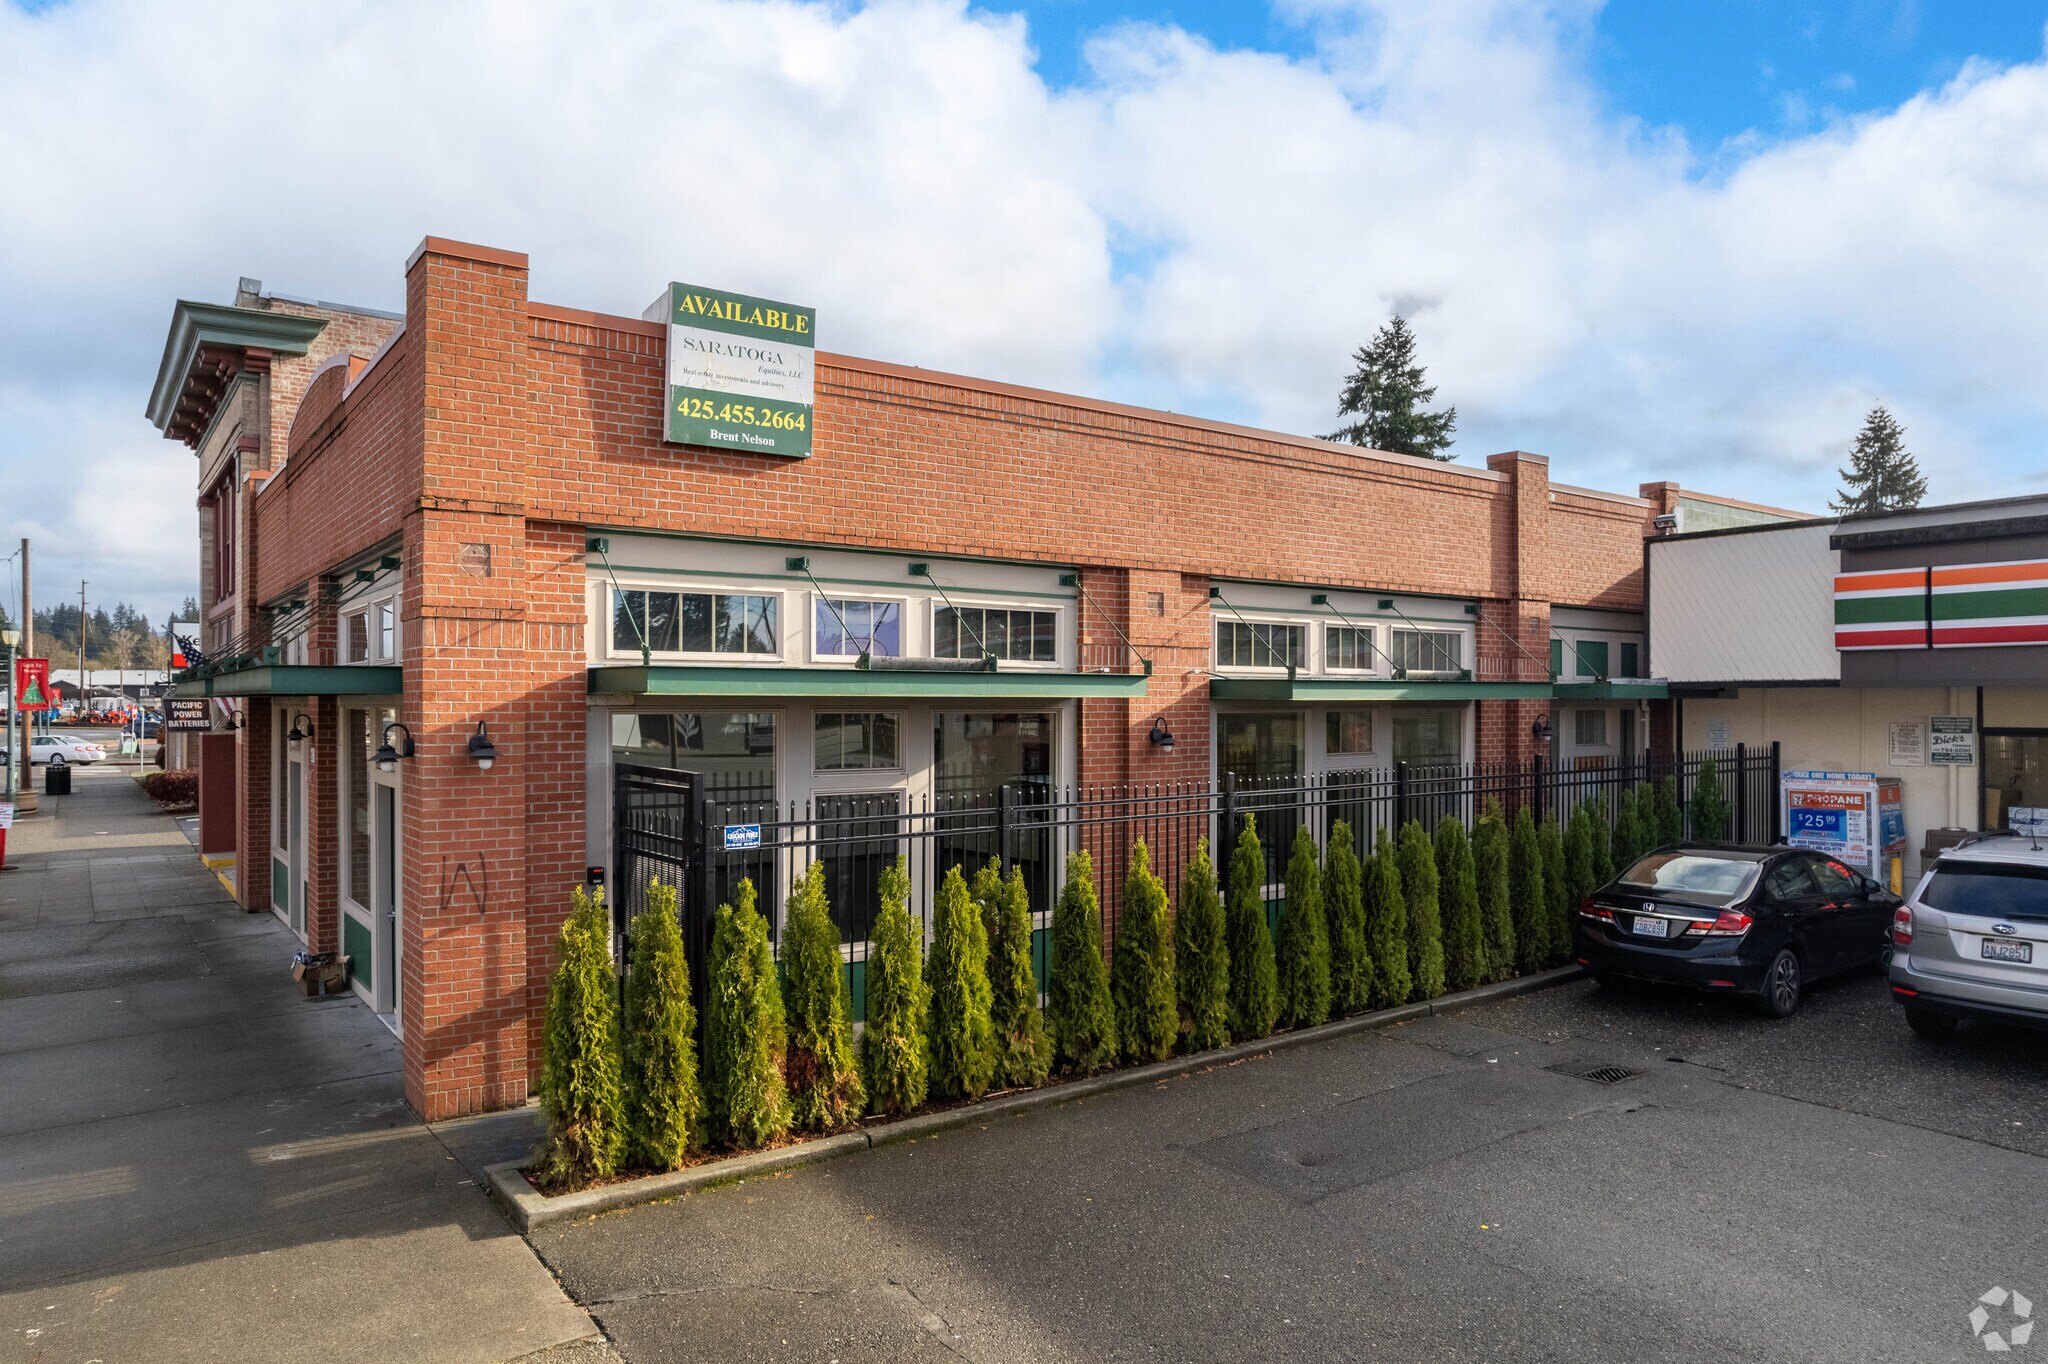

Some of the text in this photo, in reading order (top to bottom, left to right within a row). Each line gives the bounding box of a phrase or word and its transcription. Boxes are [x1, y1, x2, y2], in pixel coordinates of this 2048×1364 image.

[679, 294, 809, 333] AVAILABLE
[683, 336, 784, 365] SARATOGA
[682, 367, 697, 376] Real
[715, 373, 749, 384] investments
[761, 380, 785, 390] advisory
[757, 365, 804, 379] Equities, LLC
[677, 397, 806, 432] 425.455.2664
[709, 428, 775, 447] Brent Nelson
[171, 701, 203, 709] PACIFIC
[173, 710, 203, 719] POWER
[168, 720, 210, 728] BATTERIES
[1932, 735, 1964, 745] Dick's
[1807, 794, 1862, 804] PROPANE
[1805, 815, 1824, 827] 25
[1984, 945, 2026, 959] ANJ2851
